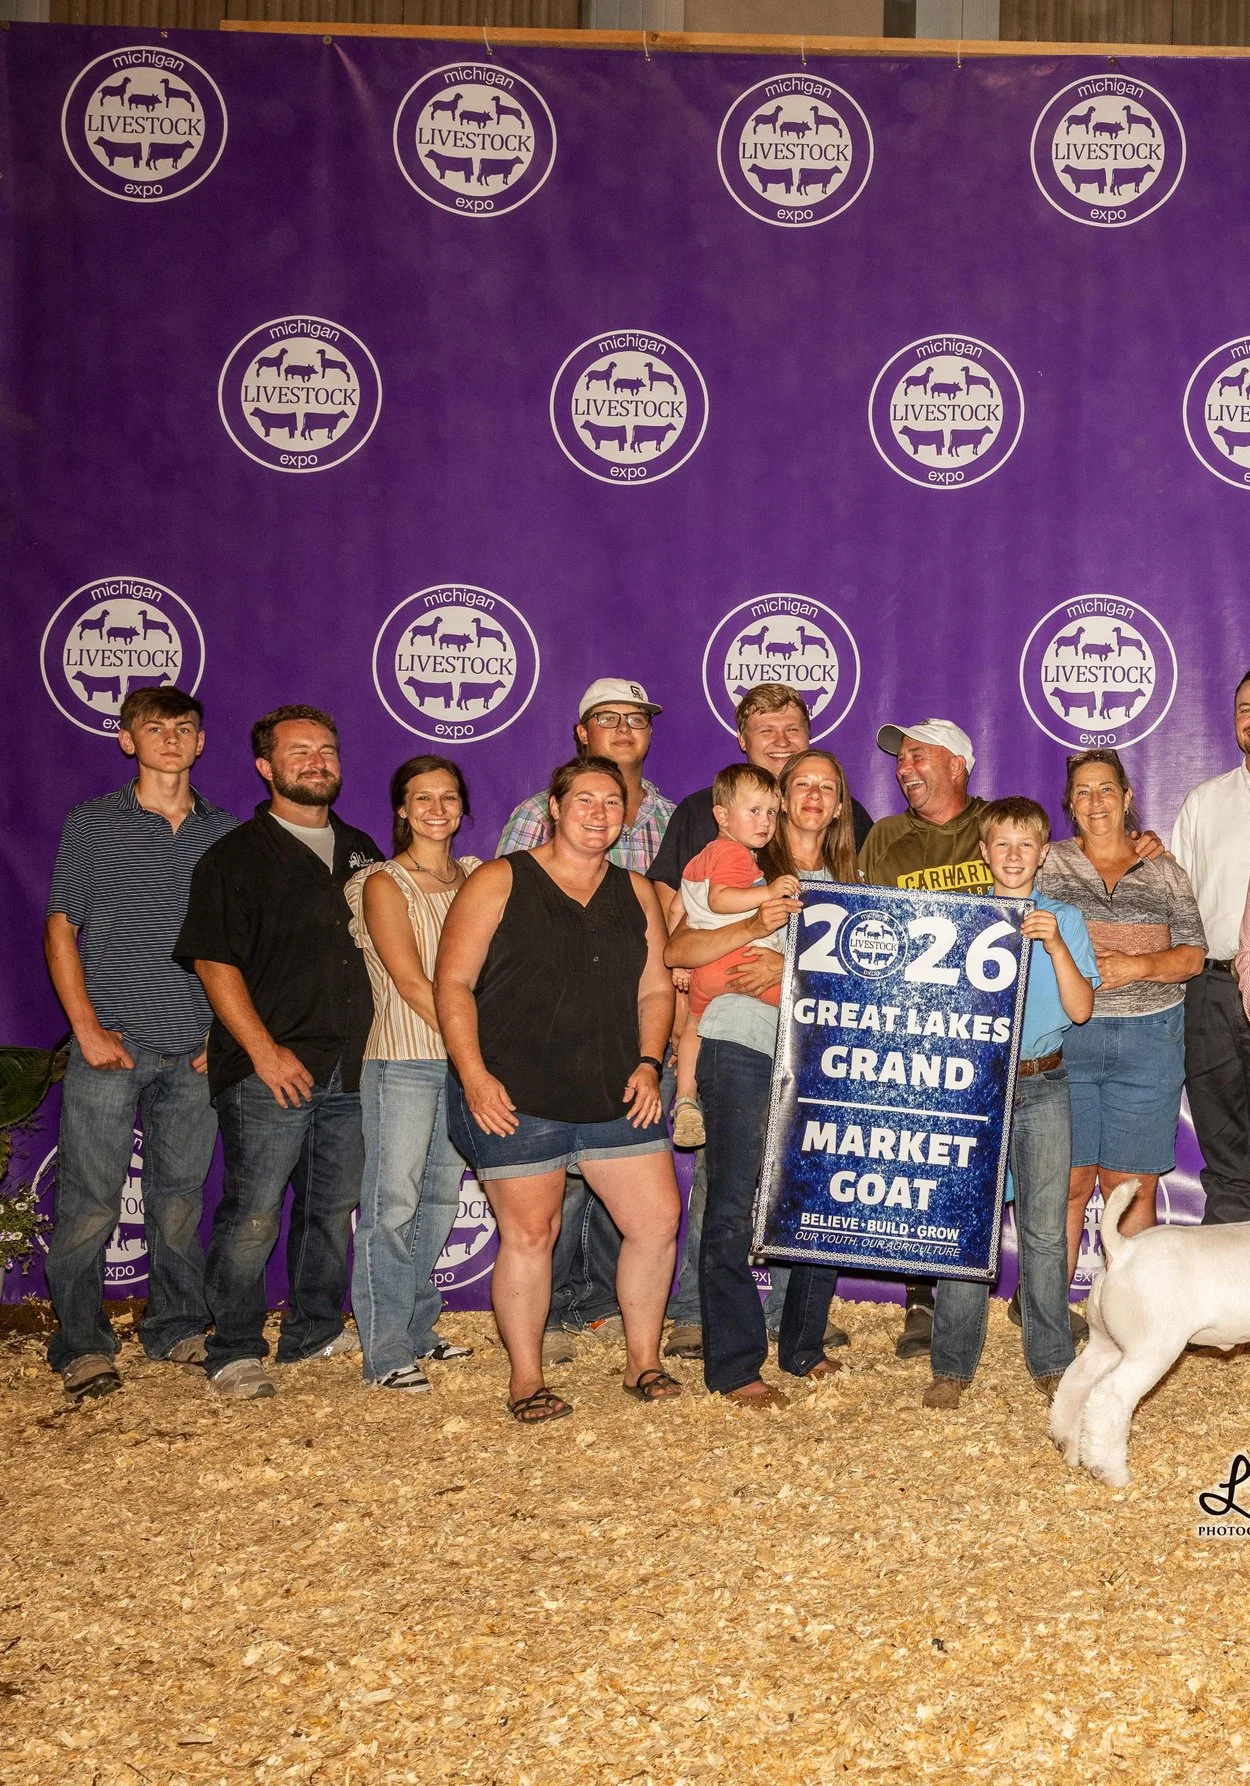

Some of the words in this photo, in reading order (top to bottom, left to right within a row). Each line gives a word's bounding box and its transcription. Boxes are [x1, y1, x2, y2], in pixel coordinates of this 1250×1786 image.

[112, 50, 185, 72] michigan
[443, 66, 515, 90] michigan
[764, 77, 832, 99] michigan
[1077, 76, 1144, 99] michigan
[87, 114, 202, 136] LIVESTOCK
[418, 127, 532, 153] LIVESTOCK
[741, 142, 849, 162] LIVESTOCK
[1054, 142, 1162, 161] LIVESTOCK
[124, 183, 164, 199] expo
[455, 197, 496, 214] expo
[776, 208, 814, 224] expo
[1090, 208, 1127, 224] expo
[269, 319, 340, 342] michigan
[598, 333, 667, 355] michigan
[915, 336, 983, 359] michigan
[243, 385, 357, 406] LIVESTOCK
[574, 398, 684, 418] LIVESTOCK
[892, 404, 1001, 422] LIVESTOCK
[279, 453, 318, 469] expo
[609, 466, 647, 481] expo
[927, 470, 965, 486] expo
[90, 580, 163, 603] michigan
[423, 588, 496, 611] michigan
[750, 596, 819, 619] michigan
[1066, 598, 1135, 620] michigan
[65, 648, 179, 668] LIVESTOCK
[397, 653, 514, 676] LIVESTOCK
[726, 663, 836, 682] LIVESTOCK
[1043, 665, 1153, 684] LIVESTOCK
[102, 716, 122, 731] ex
[434, 722, 476, 739] expo
[1079, 733, 1118, 749] expo
[904, 862, 989, 889] CARHART
[793, 998, 900, 1032] GREAT
[907, 1008, 1012, 1044] LAKES
[820, 1045, 975, 1091] GRAND
[801, 1120, 978, 1168] MARKET
[829, 1170, 938, 1211] GOAT
[800, 1212, 859, 1230] BELIEVE
[866, 1219, 909, 1236] BUILD
[916, 1225, 960, 1241] GROW
[795, 1231, 819, 1241] OUR
[861, 1238, 885, 1249] OUR
[883, 1240, 961, 1257] AGRICULTURE
[104, 1265, 135, 1281] xpo
